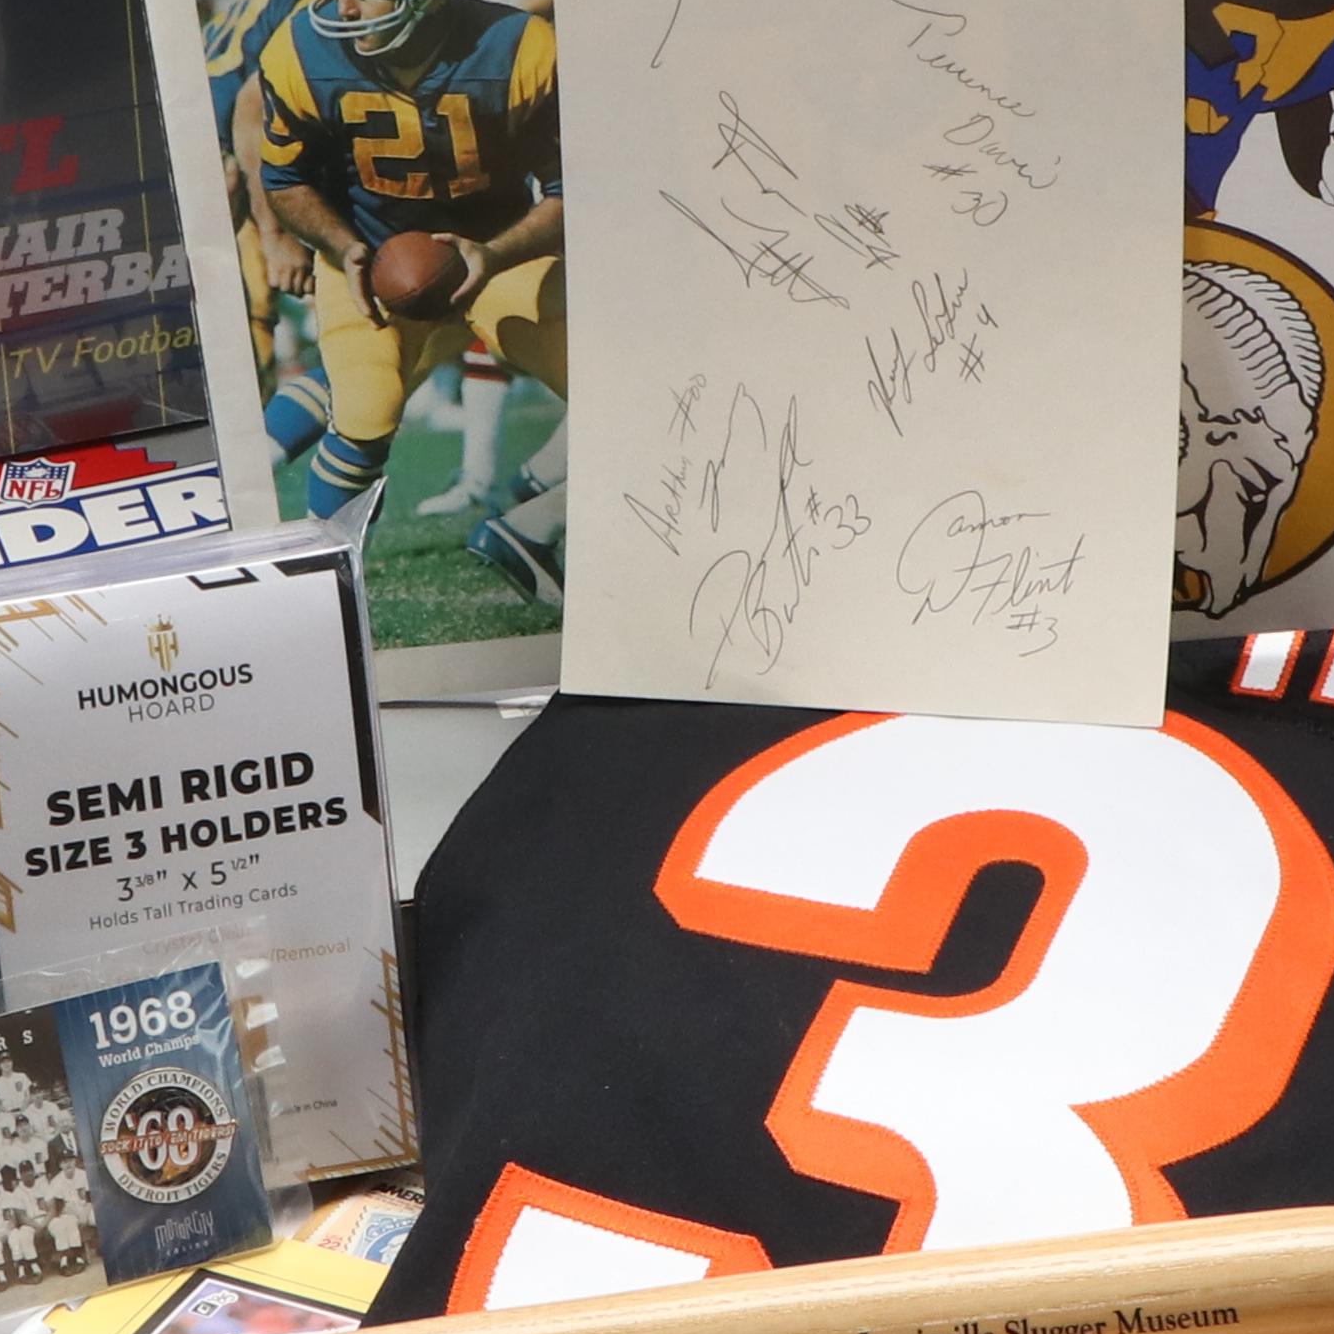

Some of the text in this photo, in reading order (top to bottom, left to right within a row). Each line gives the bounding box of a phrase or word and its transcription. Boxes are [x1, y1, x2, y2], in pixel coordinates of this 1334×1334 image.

[342, 91, 491, 200] 21
[11, 344, 62, 378] TV
[77, 663, 254, 711] HUMONGOUS
[128, 694, 216, 723] HOARD
[47, 750, 314, 827] SEMI RIGID
[24, 796, 348, 877] SIZE HOLDERS
[89, 882, 298, 931] Holds Trading Cards
[89, 989, 197, 1051] 1968
[99, 1041, 153, 1069] World
[105, 1082, 143, 1132] WORLD
